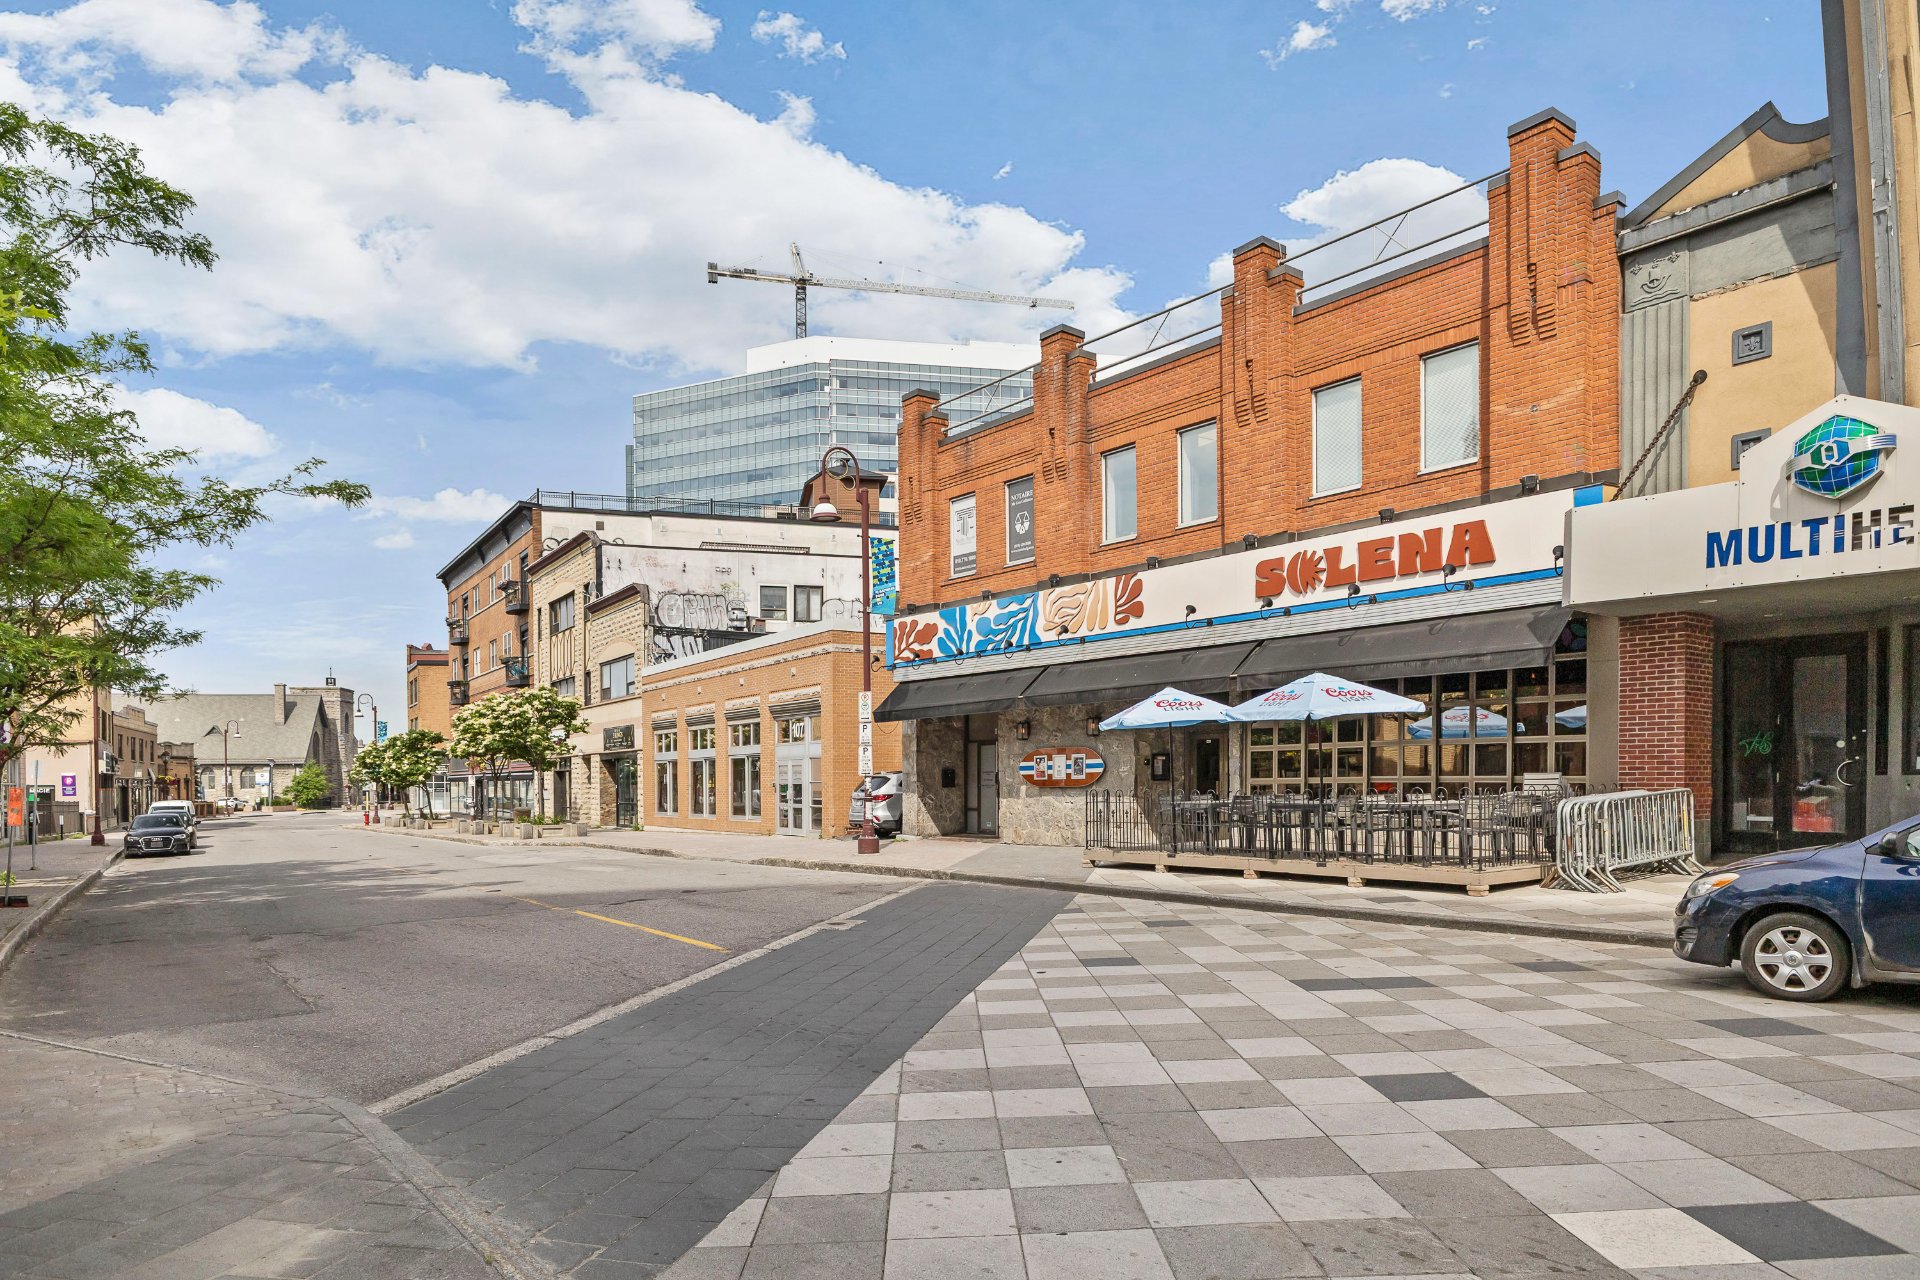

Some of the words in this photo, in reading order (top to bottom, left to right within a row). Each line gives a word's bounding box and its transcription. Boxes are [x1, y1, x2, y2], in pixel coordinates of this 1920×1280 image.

[1011, 490, 1033, 501] NOTAIRE
[1255, 520, 1496, 598] SOLENA
[1321, 687, 1373, 697] Coors
[1154, 699, 1203, 707] Coors
[792, 722, 804, 738] 107
[862, 724, 867, 733] P
[862, 746, 868, 755] P
